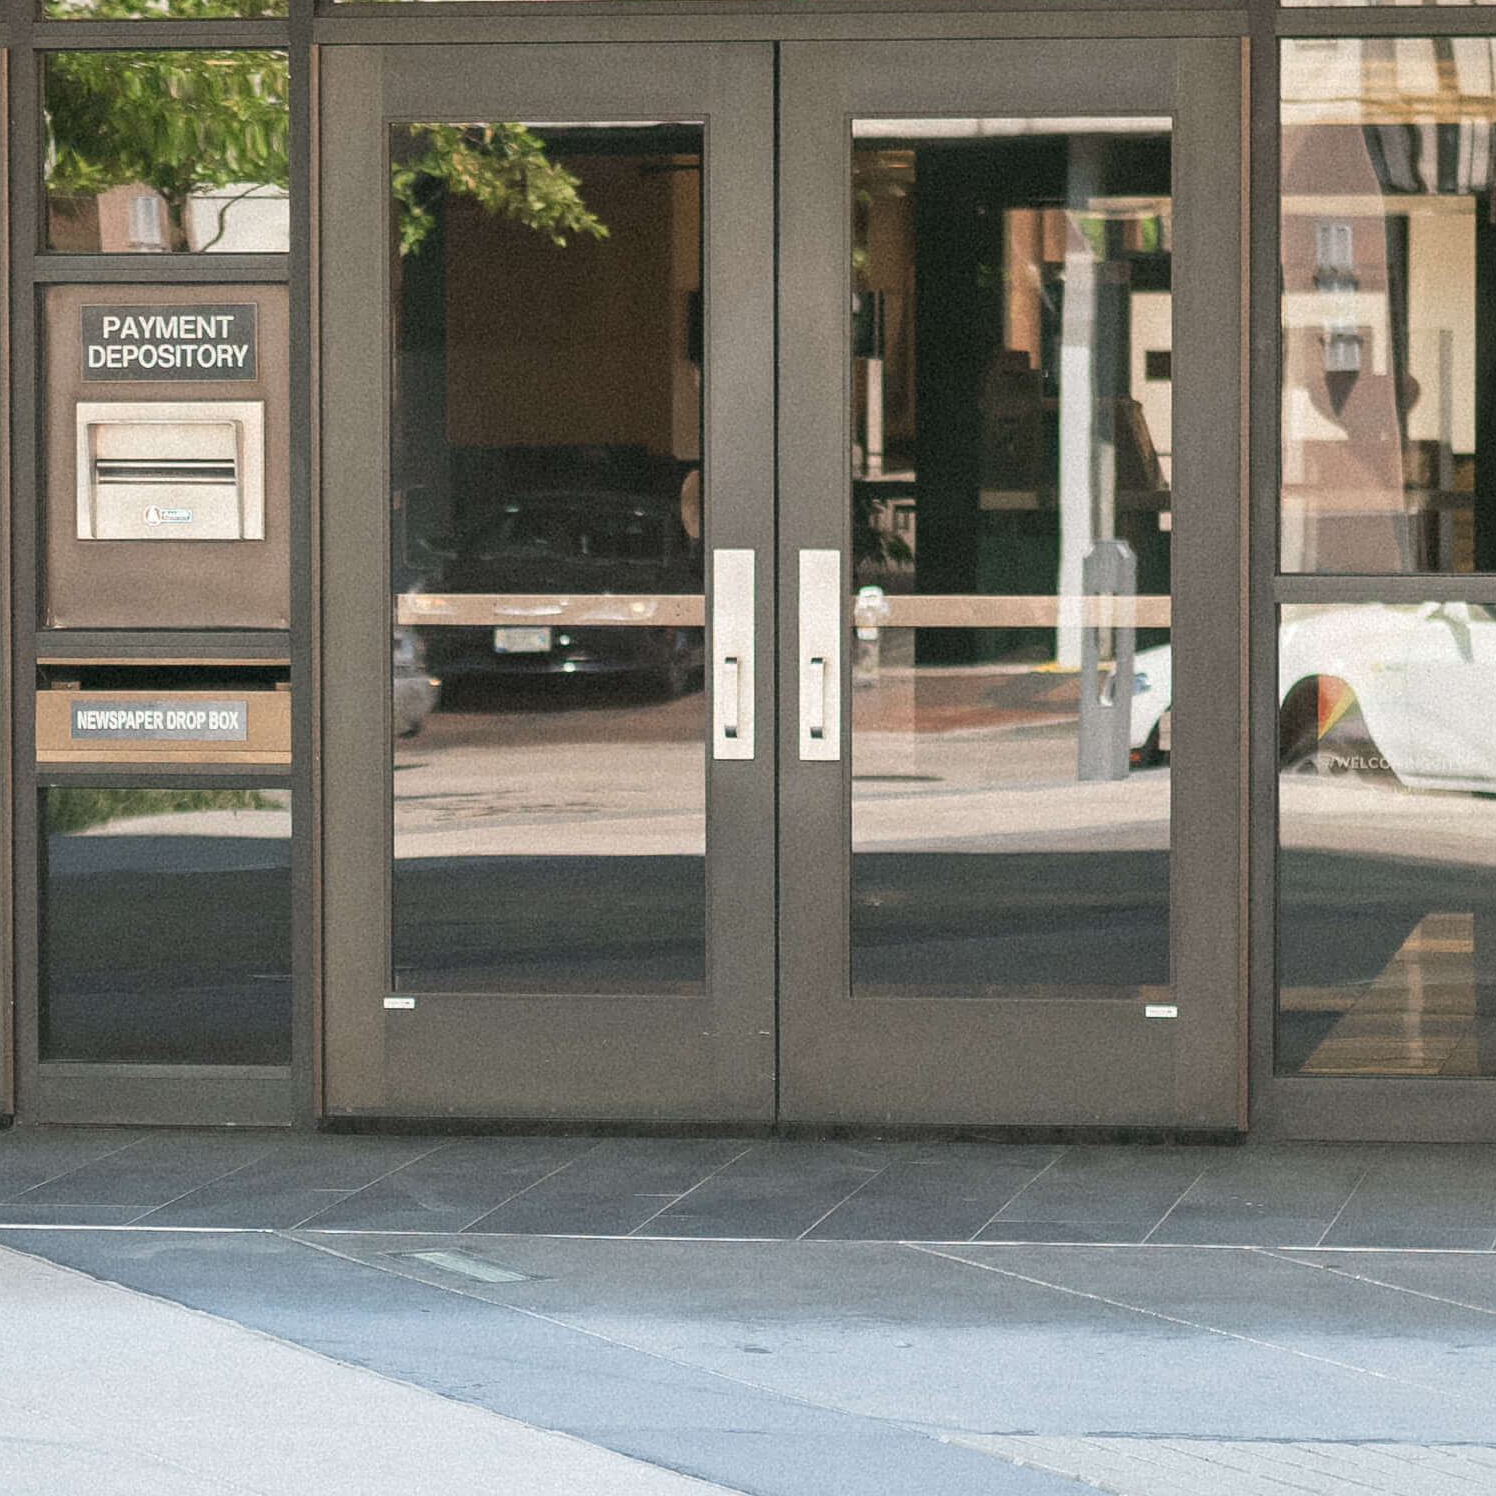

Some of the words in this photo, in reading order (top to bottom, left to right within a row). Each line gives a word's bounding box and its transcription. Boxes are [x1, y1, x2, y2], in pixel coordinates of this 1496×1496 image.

[102, 315, 235, 340] PAYMENT
[88, 344, 249, 369] DEPOSITORY
[77, 710, 165, 730] NEWSPAPER
[166, 711, 206, 730] DROP
[208, 711, 240, 730] BOX
